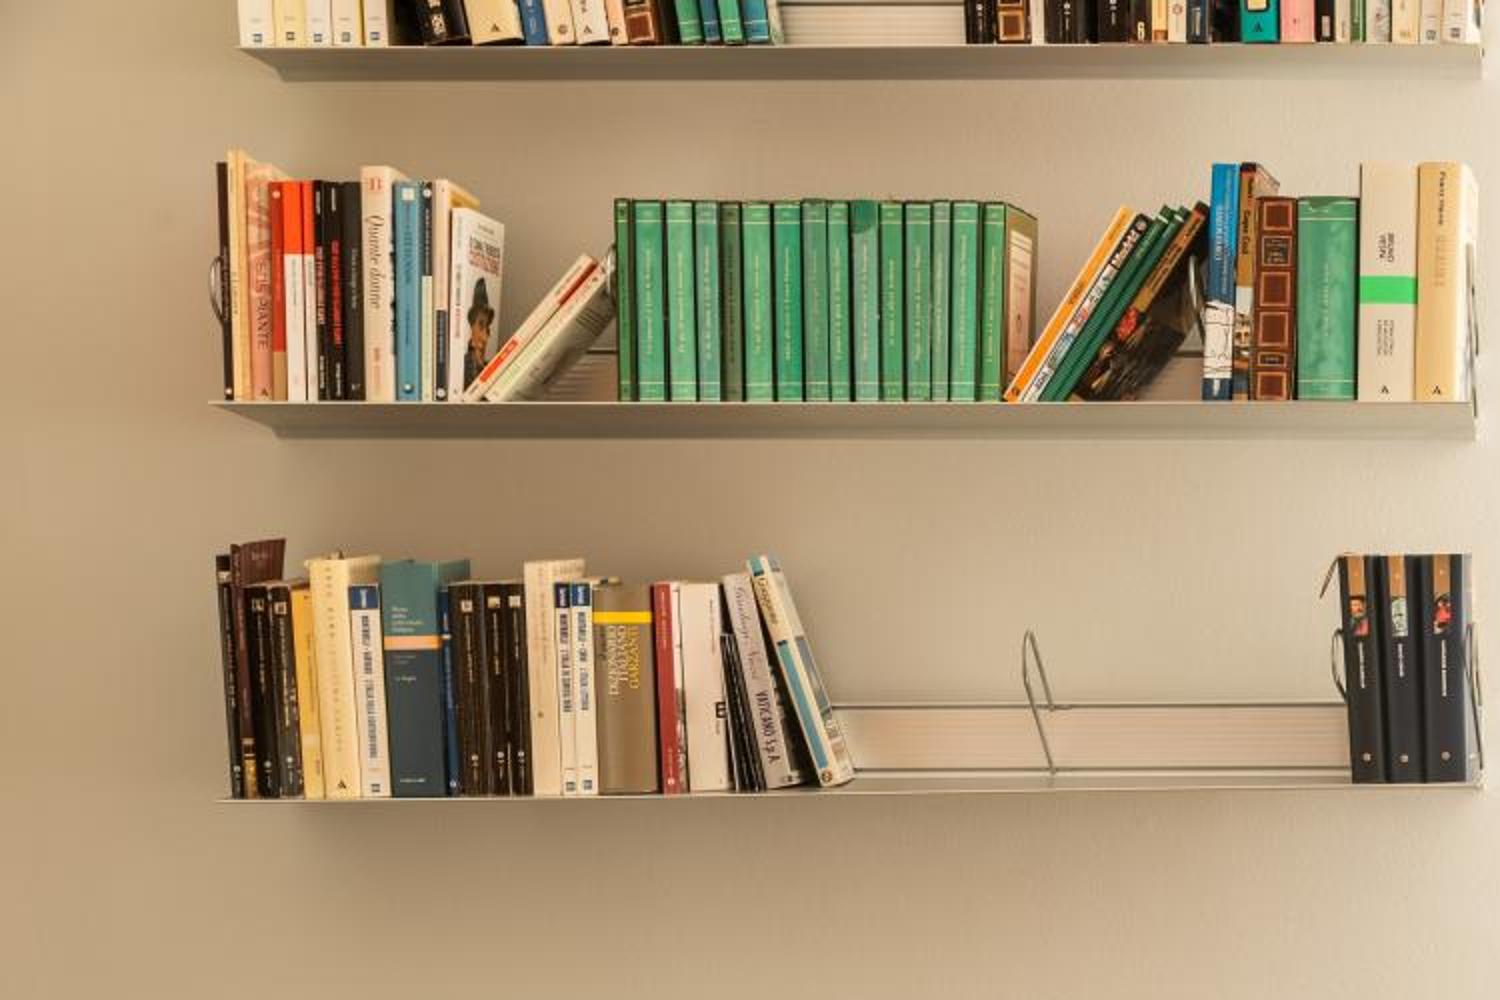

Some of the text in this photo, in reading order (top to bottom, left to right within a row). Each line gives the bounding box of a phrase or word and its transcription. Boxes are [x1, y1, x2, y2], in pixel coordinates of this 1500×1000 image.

[364, 214, 388, 310] Quante donne
[755, 690, 776, 737] VATICANO
